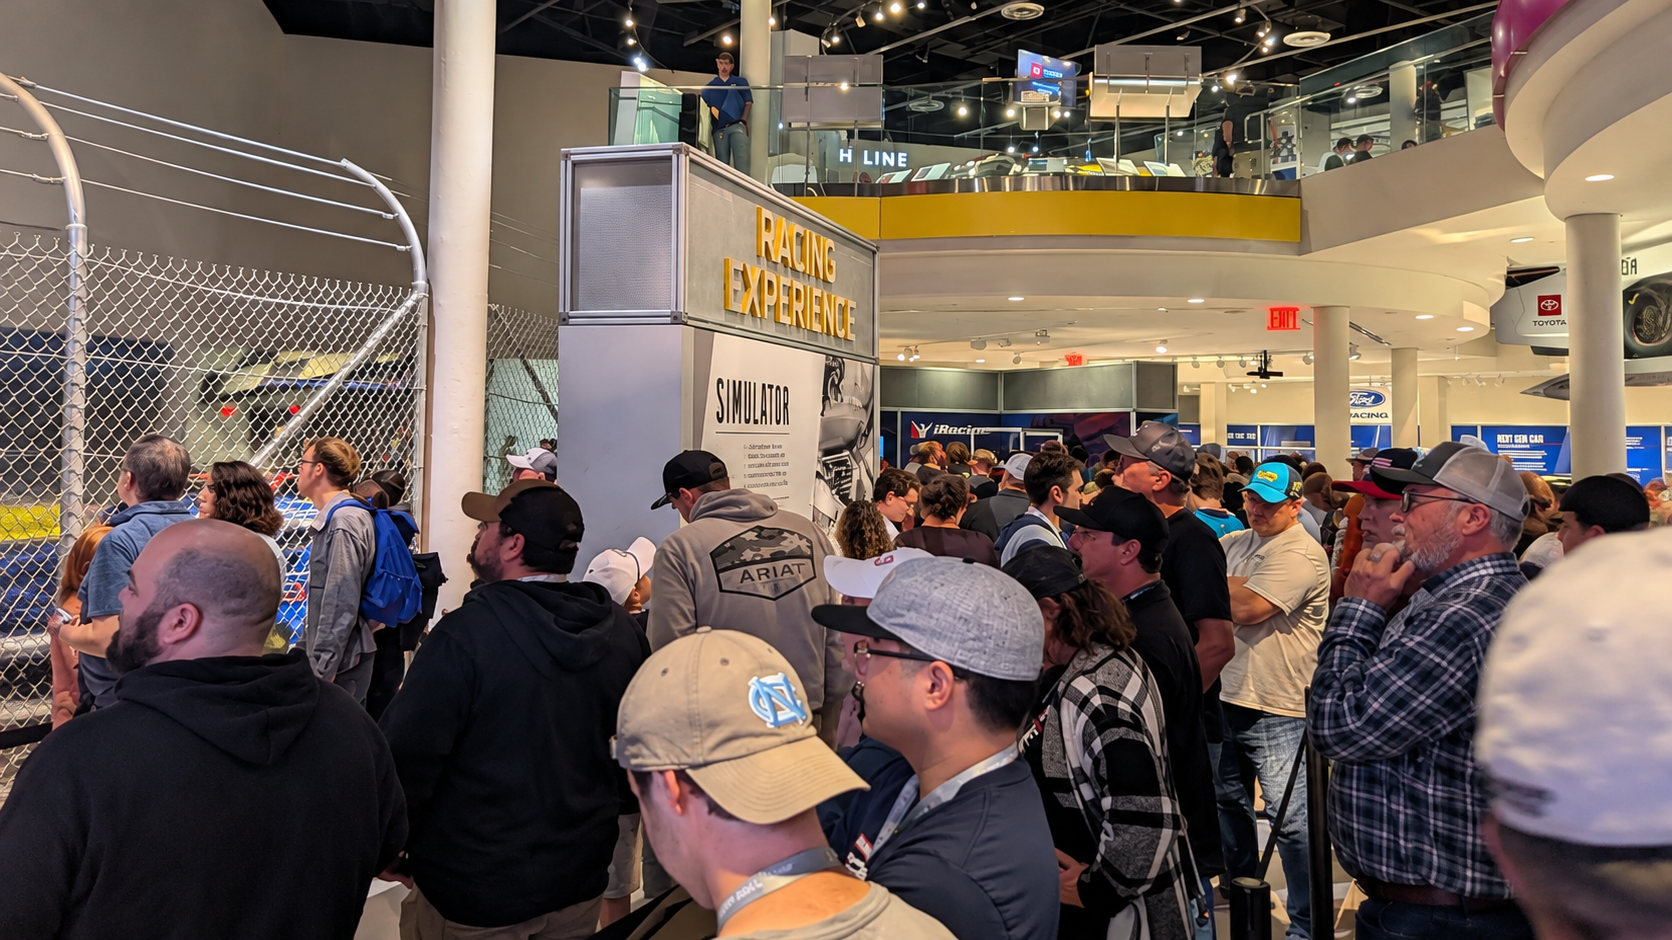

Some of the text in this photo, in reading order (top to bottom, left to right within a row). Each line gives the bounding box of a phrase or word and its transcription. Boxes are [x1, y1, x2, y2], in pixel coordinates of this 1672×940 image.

[863, 150, 908, 167] LINE
[756, 205, 836, 284] RACING
[724, 257, 857, 341] EXPERIENCE
[1532, 319, 1567, 327] TOYOTA
[716, 377, 790, 425] SIMULATOR
[739, 563, 806, 584] ARIAT
